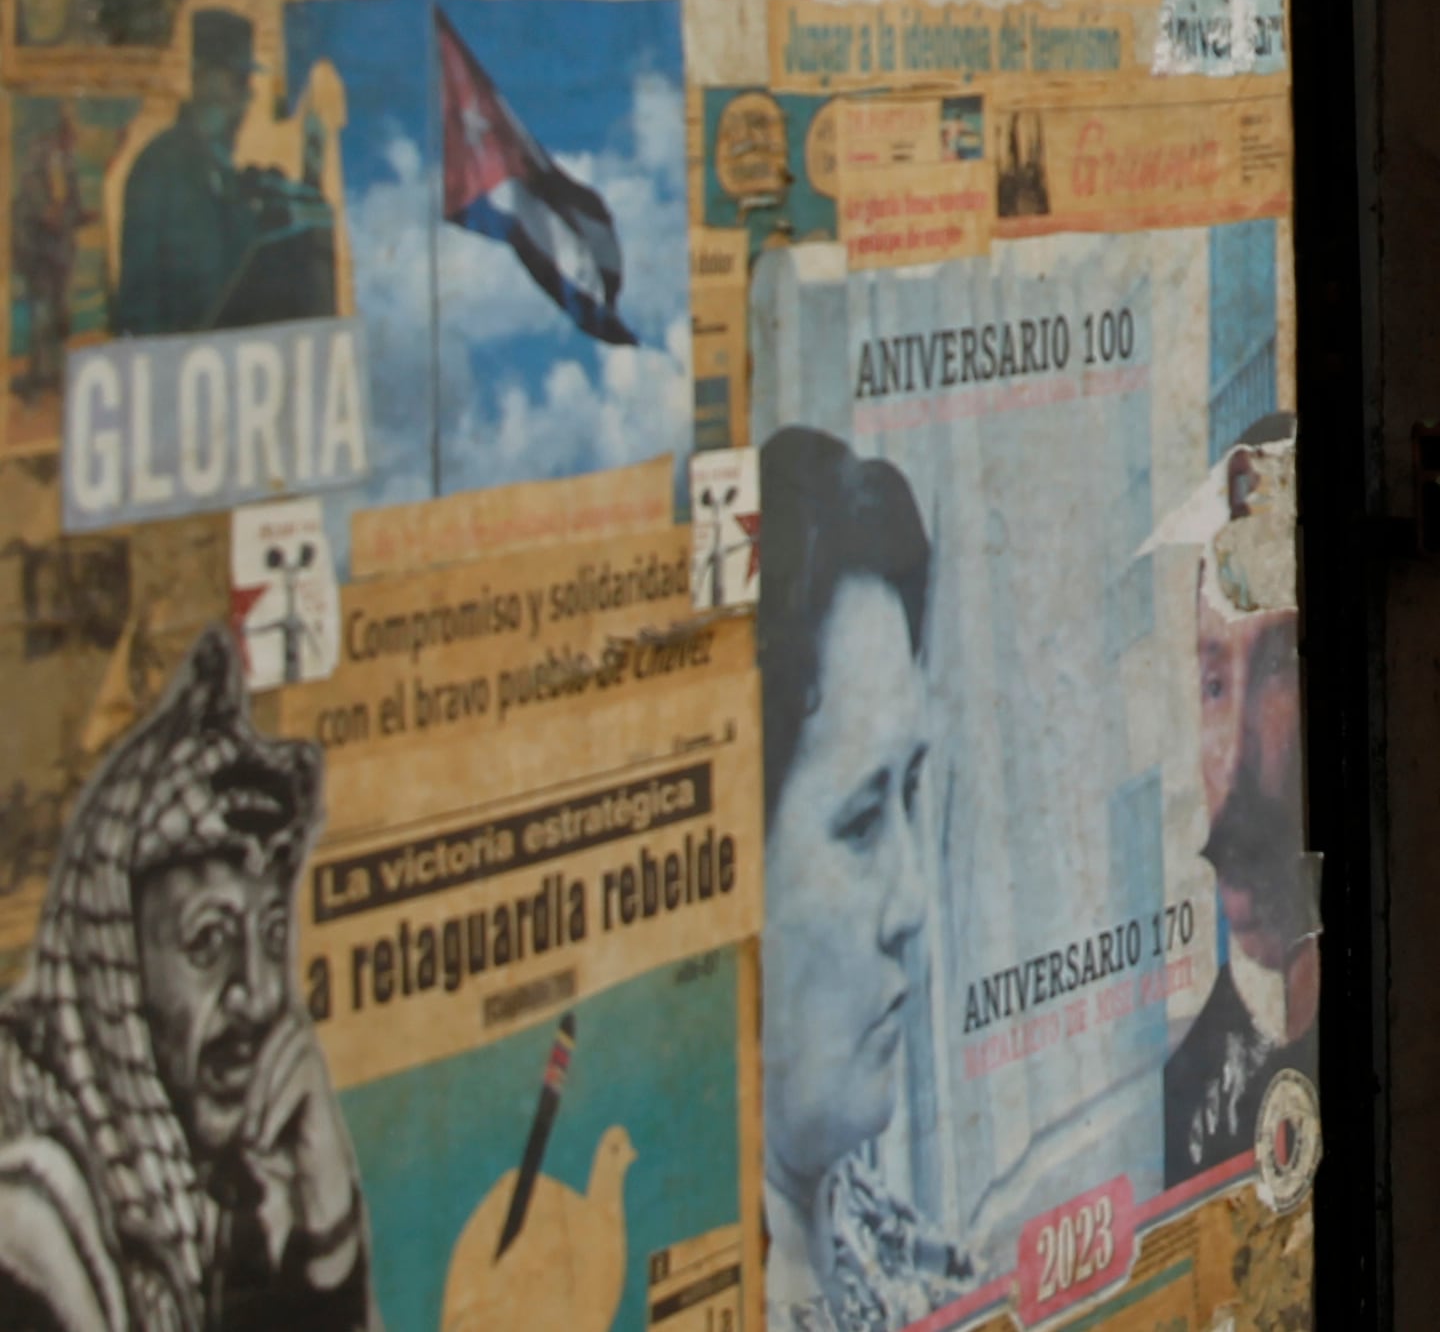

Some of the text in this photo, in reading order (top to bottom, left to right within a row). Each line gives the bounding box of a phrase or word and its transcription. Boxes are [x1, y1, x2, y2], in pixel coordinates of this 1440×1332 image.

[854, 307, 1134, 400] ANIVERSARIO 100
[70, 332, 367, 514] GLORIA
[345, 581, 522, 666] Compromiso
[527, 588, 544, 640] y
[317, 701, 371, 750] con
[379, 676, 407, 736] el
[413, 665, 491, 729] bravo
[320, 772, 697, 909] La victoria estratégica
[350, 871, 589, 1013] retaguardia
[602, 824, 737, 933] rebelde
[962, 899, 1195, 1035] ANIVERSARIO 170
[1035, 1197, 1115, 1303] 2023
